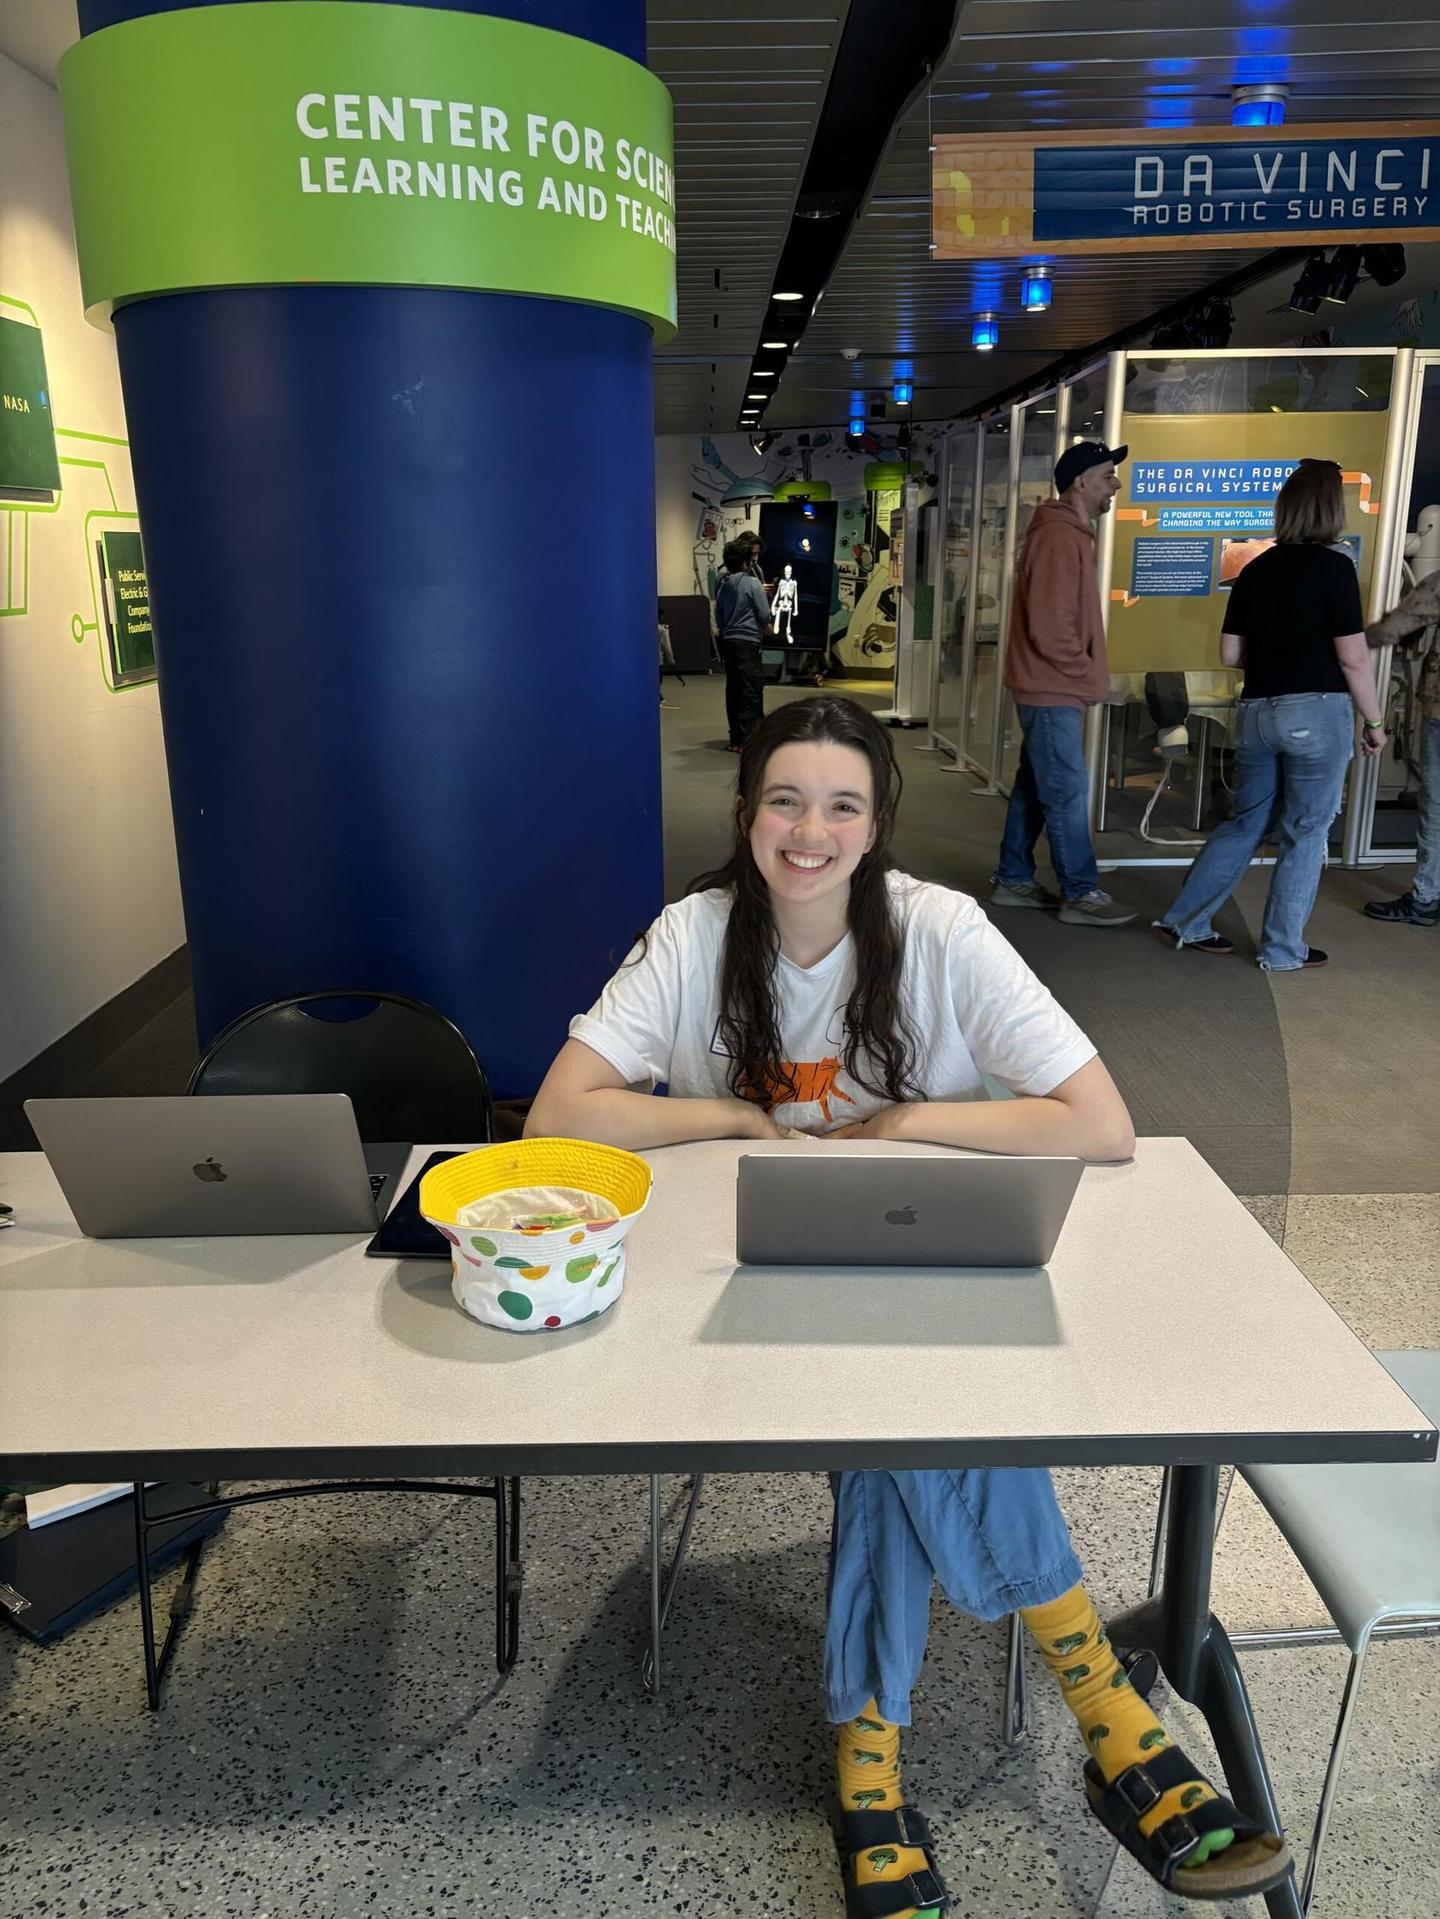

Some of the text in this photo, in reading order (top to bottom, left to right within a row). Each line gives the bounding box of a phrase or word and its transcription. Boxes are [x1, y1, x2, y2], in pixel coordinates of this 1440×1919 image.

[296, 92, 511, 152] CENTER
[527, 113, 606, 172] FOR
[1134, 148, 1431, 199] DA VINCI
[300, 156, 524, 207] LEARNING
[537, 176, 608, 221] AND
[1133, 196, 1428, 225] ROBOTIC SURGERY
[3, 394, 31, 414] NASA
[1137, 468, 1166, 479] THE
[1174, 468, 1194, 479] DA
[1202, 467, 1244, 479] VINCI
[1136, 481, 1282, 493] SURGICAL SYSTEM
[1234, 510, 1255, 518] TOOL
[1162, 519, 1204, 527] CHANGING
[118, 570, 133, 582] Public
[120, 587, 139, 600] Electric
[139, 586, 143, 598] &
